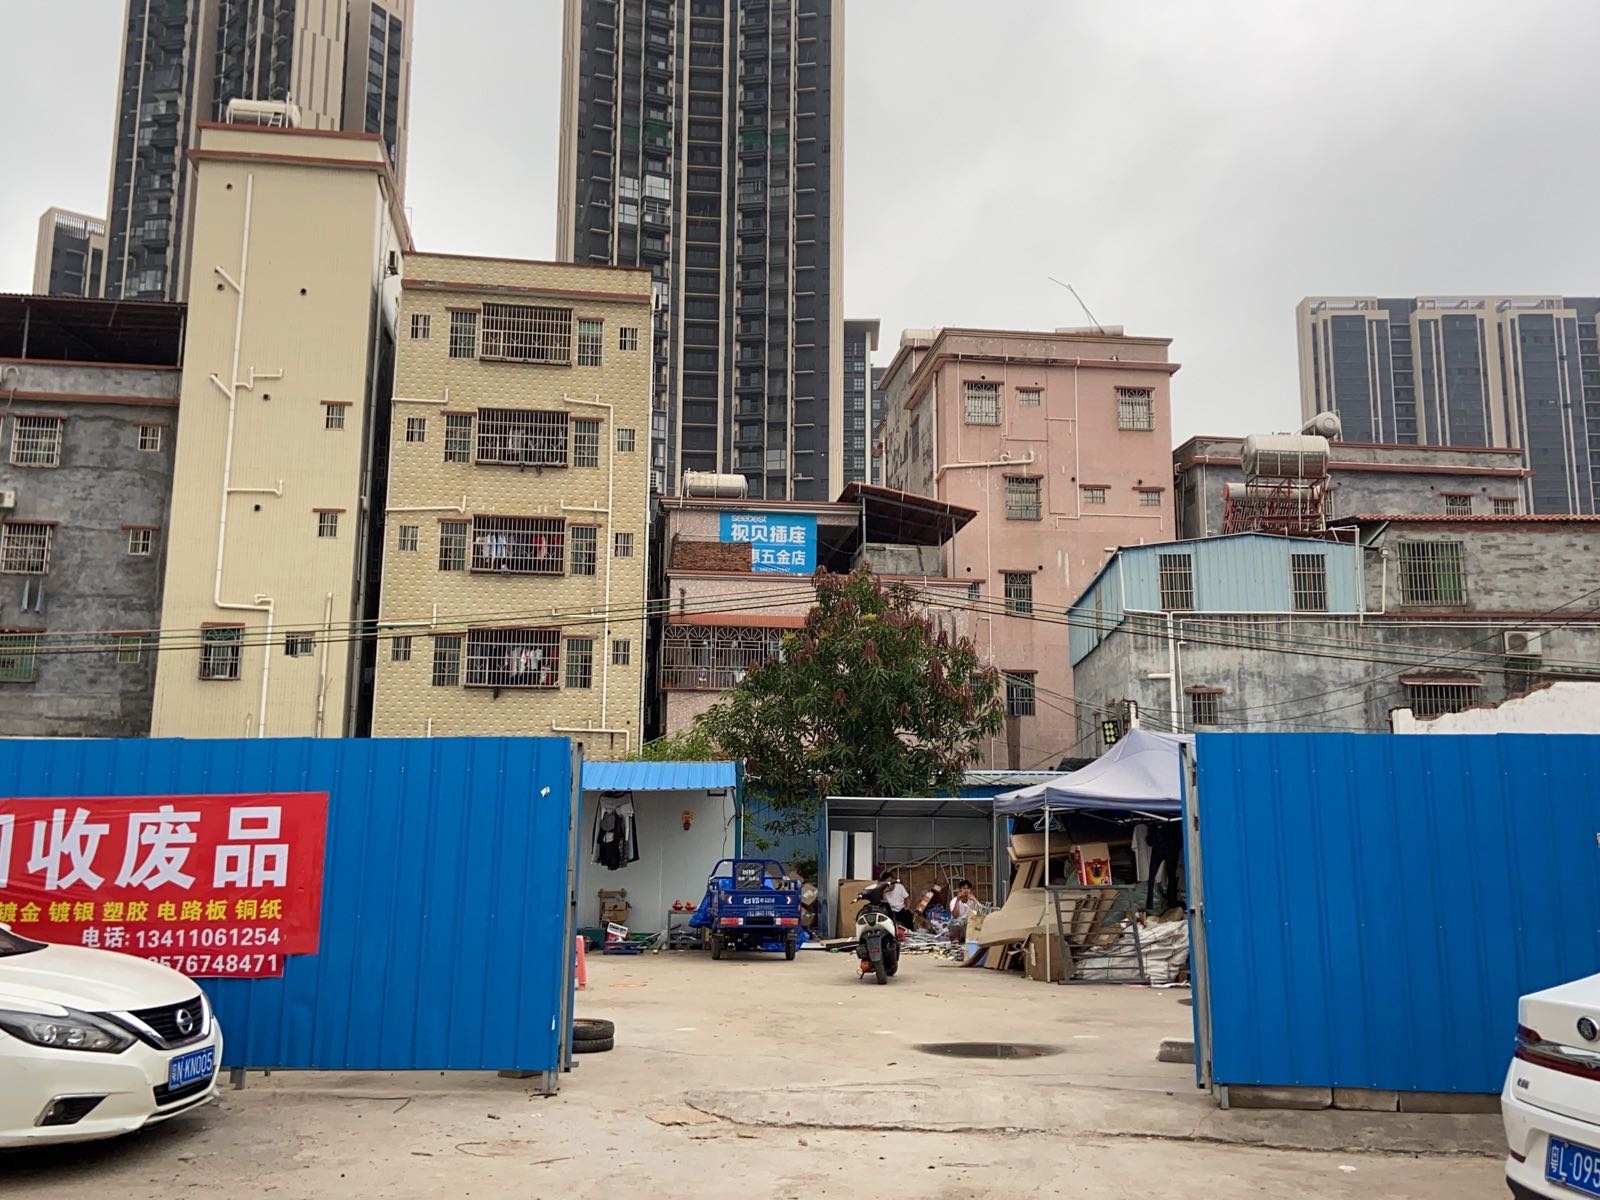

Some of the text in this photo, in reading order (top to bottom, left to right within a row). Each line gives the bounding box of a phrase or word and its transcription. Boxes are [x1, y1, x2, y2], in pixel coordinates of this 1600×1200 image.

[731, 524, 805, 544] 视贝插座
[0, 805, 289, 891] 收废品
[0, 898, 283, 923] 镀金 镀银 塑胶 电路板 铜纸
[136, 927, 281, 948] 13411061254
